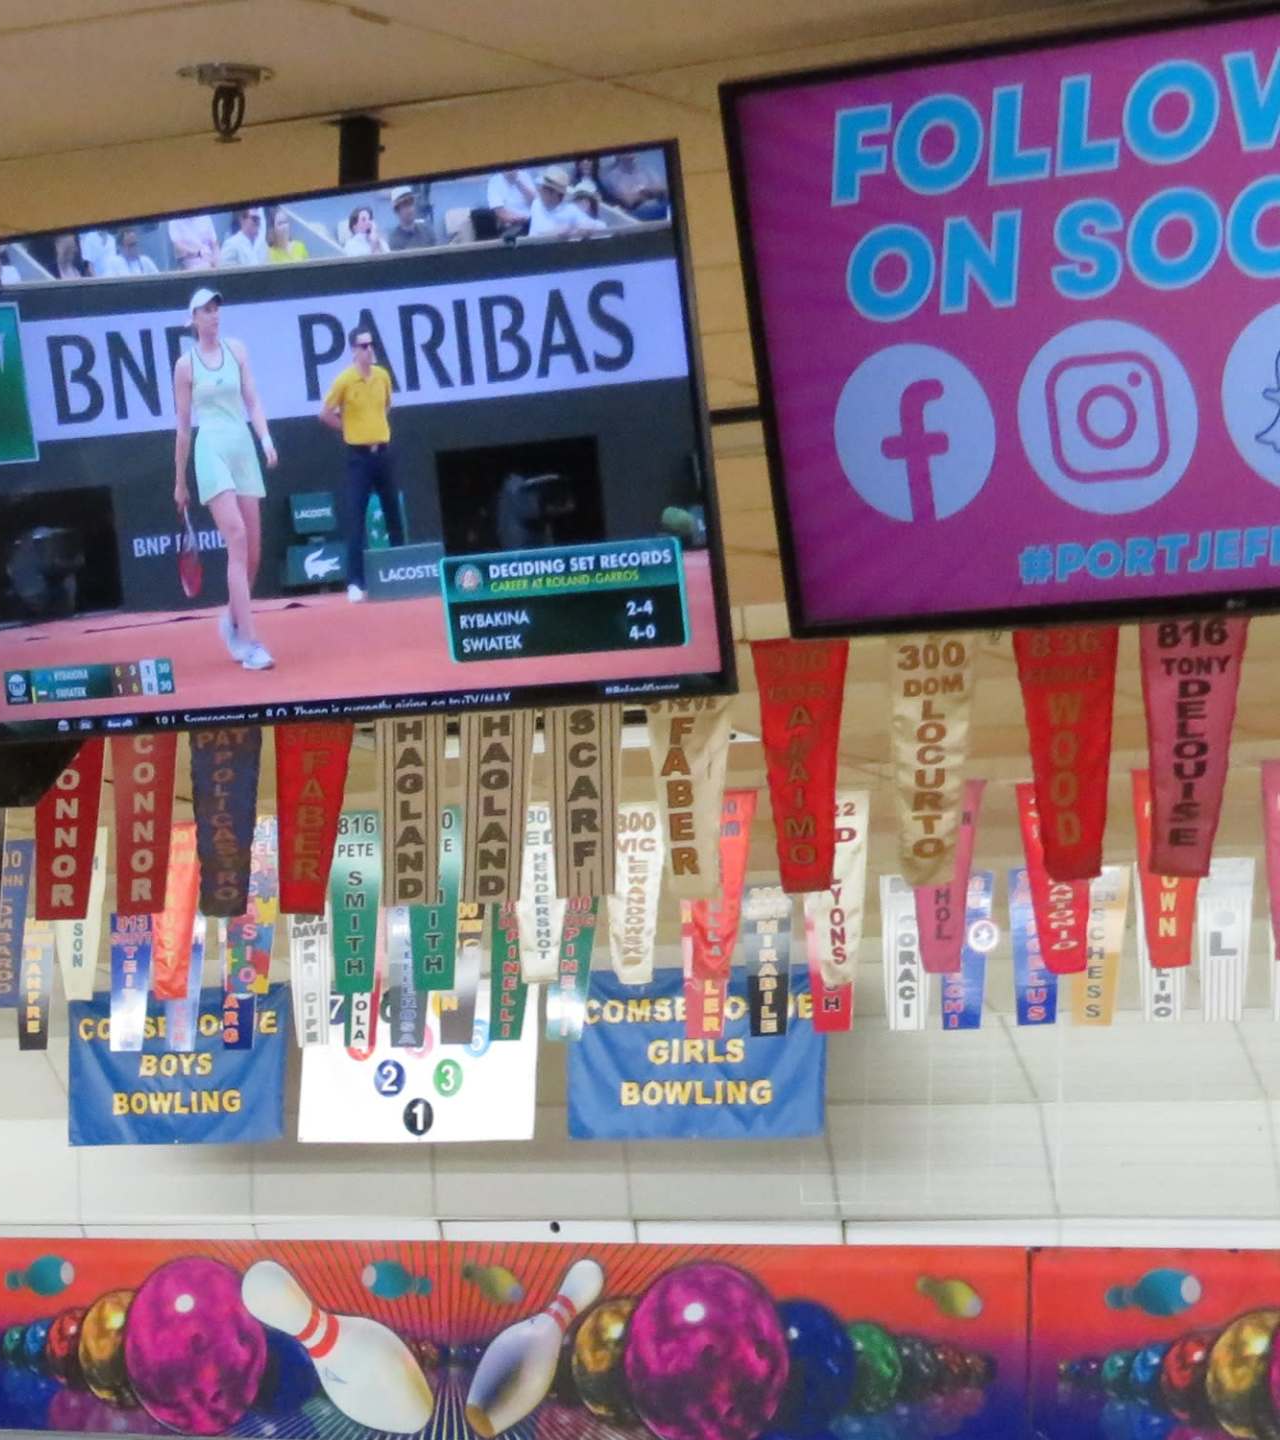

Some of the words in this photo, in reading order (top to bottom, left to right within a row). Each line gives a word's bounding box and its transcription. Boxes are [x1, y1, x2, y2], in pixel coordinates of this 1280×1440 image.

[846, 210, 1023, 323] ON
[1051, 173, 1280, 300] SOC
[298, 281, 635, 401] PARIBAS
[380, 565, 438, 582] LACOSTE
[489, 558, 564, 579] DECIDING
[569, 555, 596, 573] SET
[600, 549, 672, 572] RECORDS
[1018, 531, 1280, 585] #PORTJEF
[460, 610, 529, 630] RYBAKINA
[1157, 618, 1228, 649] 816
[462, 634, 523, 654] SWIATEK
[897, 640, 966, 671] 300
[1160, 655, 1232, 677] TONY
[903, 679, 964, 699] DOM
[197, 727, 250, 749] PAT
[1050, 692, 1083, 847] WOOD
[1169, 679, 1210, 848] DELOUISE
[568, 708, 599, 868] SCARF
[661, 716, 700, 876] FABER
[912, 702, 946, 860] LOCURTO
[131, 734, 156, 904] CONNOR
[292, 748, 326, 881] FABER
[338, 815, 376, 836] 816
[51, 766, 82, 907] ONNOR
[338, 843, 375, 859] PETE
[291, 925, 329, 939] DAVE
[345, 871, 365, 975] SMITH
[139, 1050, 215, 1080] BOYS
[646, 1037, 746, 1065] GIRLS
[111, 1087, 243, 1118] BOWLING
[619, 1078, 774, 1108] BOWLING
